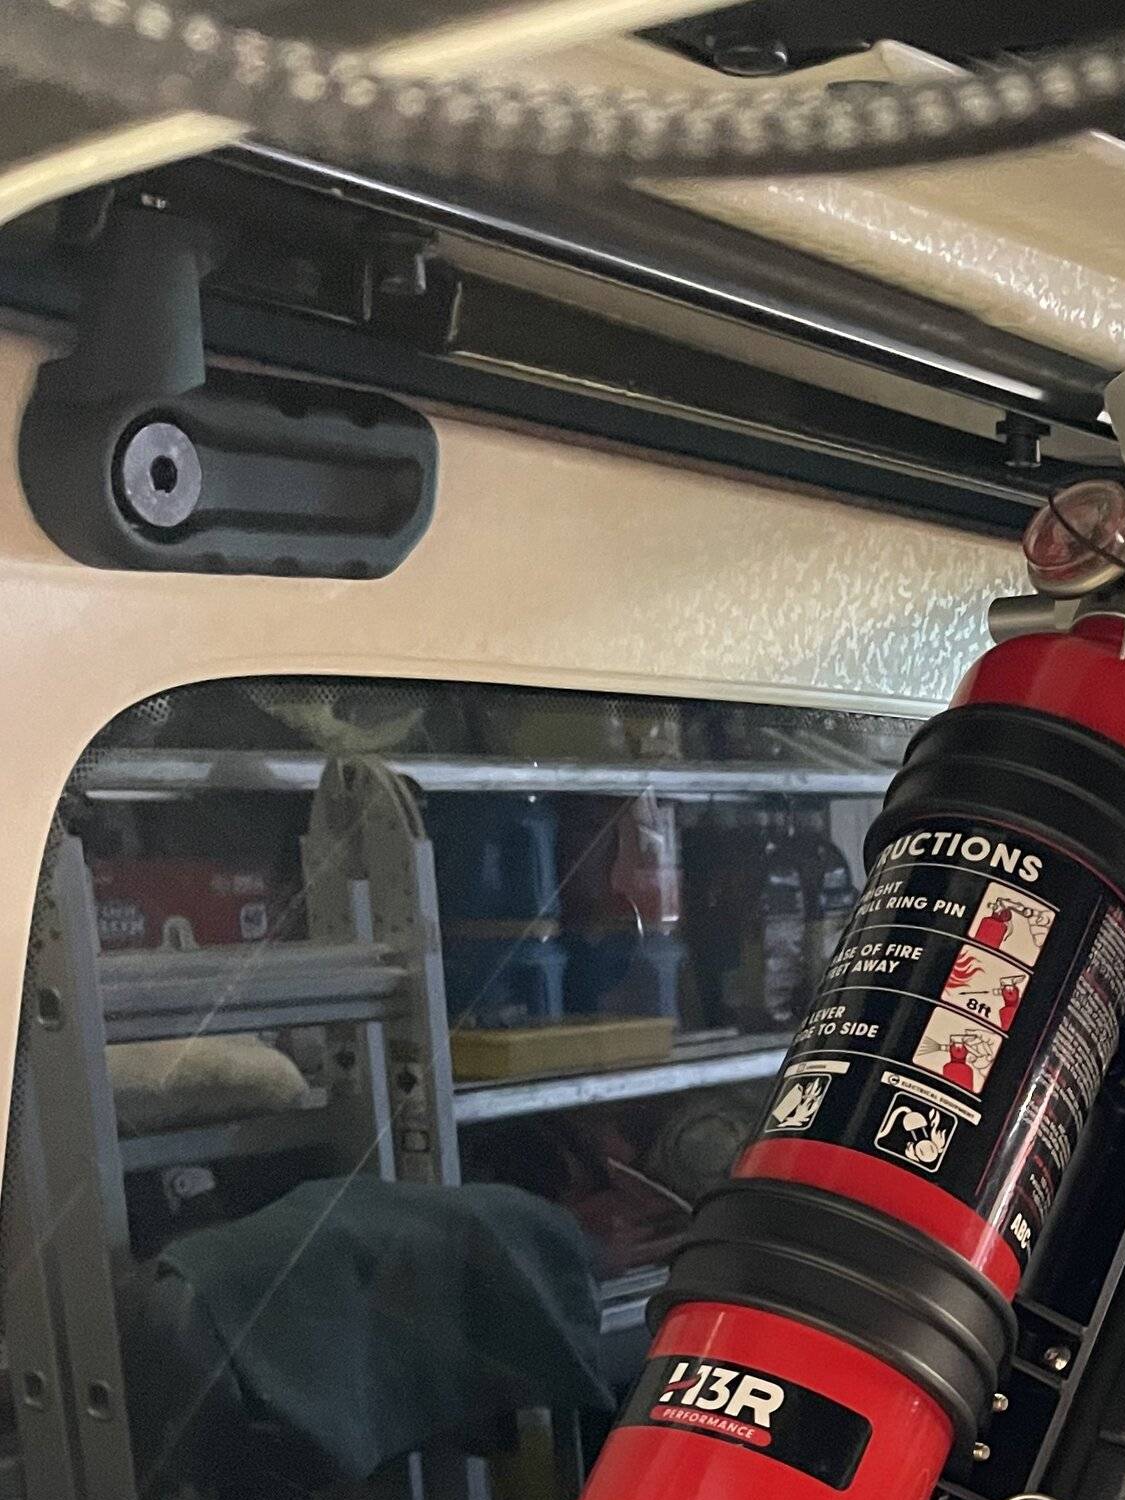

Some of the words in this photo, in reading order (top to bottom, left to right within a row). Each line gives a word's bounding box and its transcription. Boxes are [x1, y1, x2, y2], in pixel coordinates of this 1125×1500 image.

[886, 895, 928, 911] RING
[932, 899, 967, 918] PIN
[860, 943, 881, 957] OF
[885, 943, 924, 961] FIRE
[851, 959, 900, 974] AWAY
[808, 1005, 846, 1026] LEVER
[966, 997, 992, 1019] 8ft
[817, 1021, 837, 1036] TO
[840, 1022, 880, 1039] SIDE
[1010, 1212, 1032, 1249] ABC
[659, 1362, 785, 1429] H3R
[662, 1407, 755, 1439] PERFORMANCE
